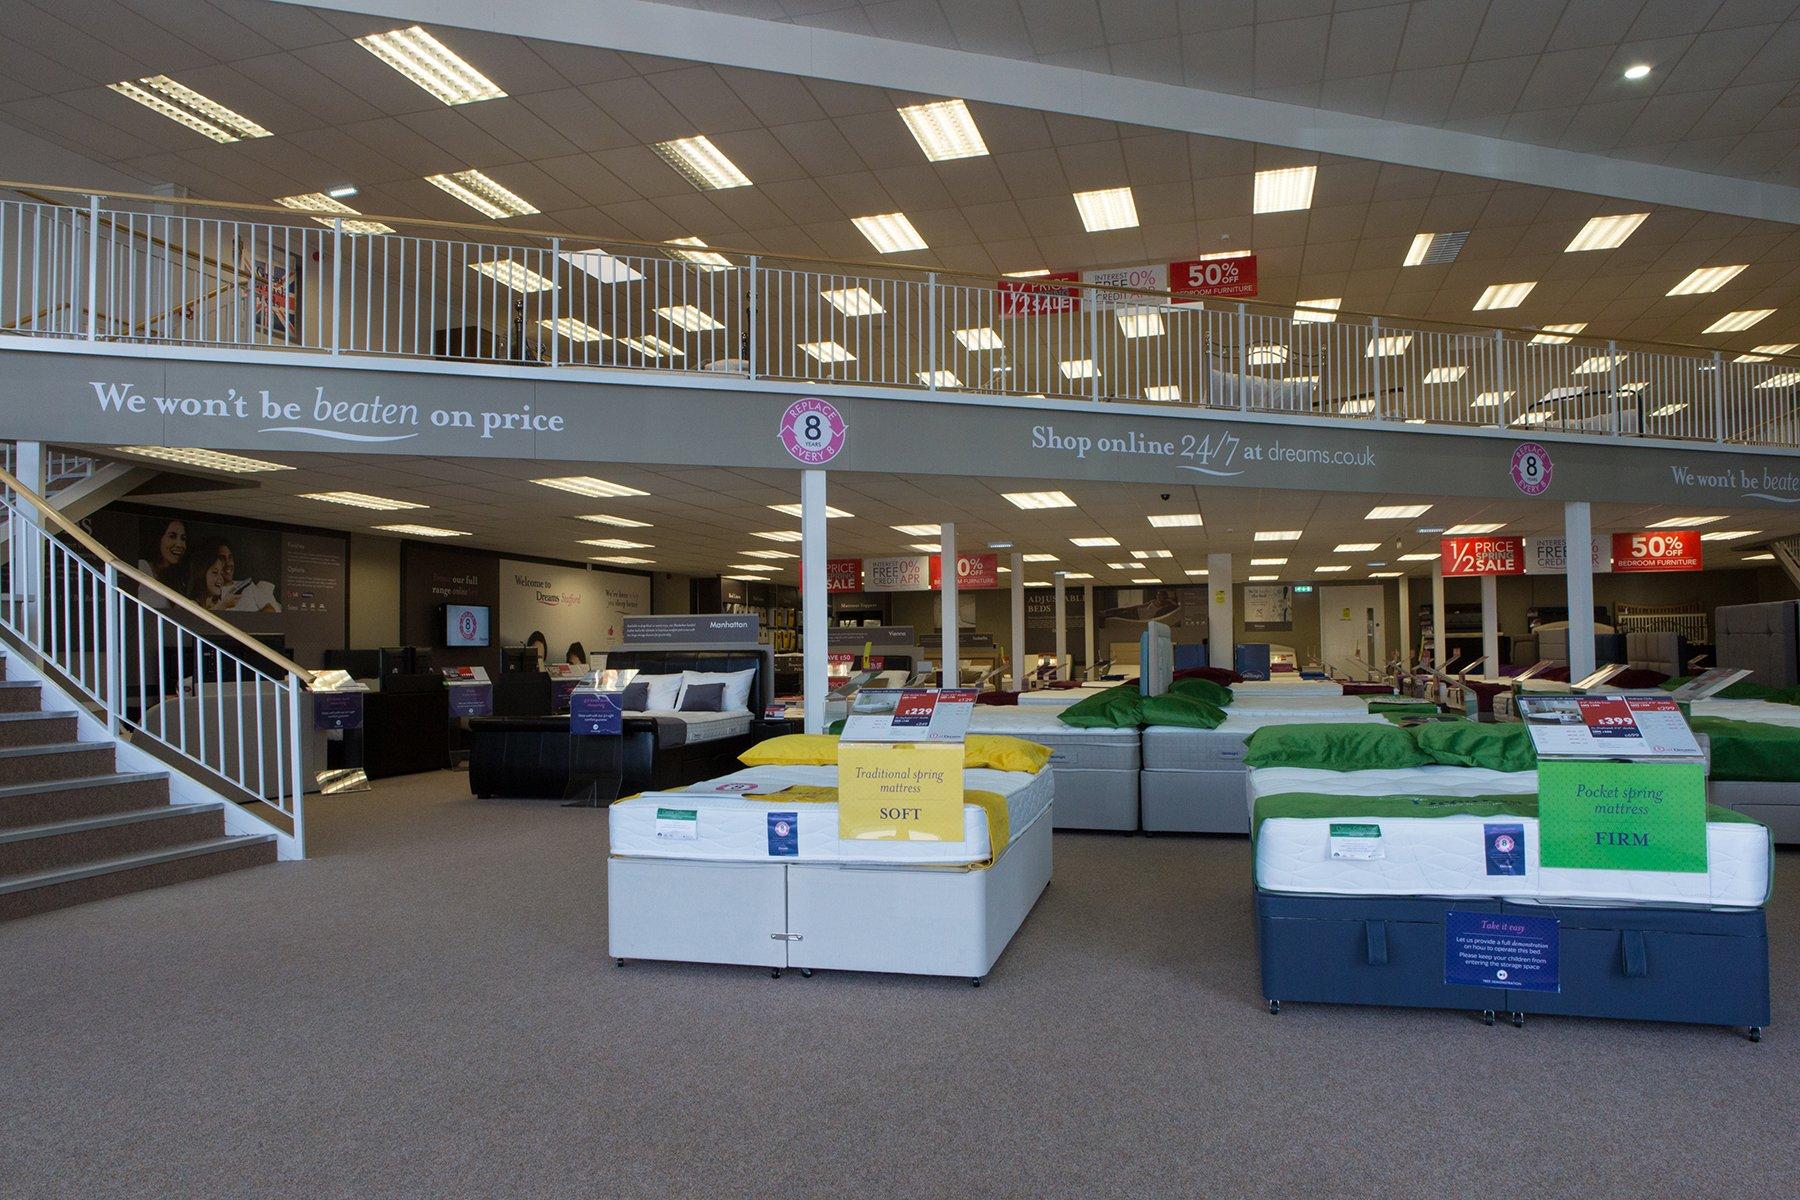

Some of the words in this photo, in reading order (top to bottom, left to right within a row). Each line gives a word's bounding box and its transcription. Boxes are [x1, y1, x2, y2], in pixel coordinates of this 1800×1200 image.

[1095, 272, 1127, 281] INTEREST
[1130, 270, 1155, 286] 0%
[1188, 262, 1239, 287] 50%
[1221, 276, 1239, 284] OFF
[1213, 285, 1253, 294] FURNITURE
[89, 382, 146, 413] We
[153, 388, 249, 418] won't
[259, 390, 301, 420] be
[313, 386, 419, 425] beaten
[430, 409, 475, 428] on
[481, 404, 564, 440] price
[789, 401, 837, 420] REPLACE
[805, 415, 821, 440] 8
[1032, 425, 1092, 459] Shop
[1097, 431, 1175, 456] online
[1180, 430, 1240, 467] 24/7
[1243, 446, 1263, 461] at
[1268, 440, 1376, 467] dreams.co.uk
[791, 444, 824, 462] EVERY
[1526, 456, 1538, 476] 8
[1670, 465, 1695, 486] We
[1697, 469, 1737, 488] won't
[1740, 469, 1760, 490] be
[1475, 541, 1514, 553] PRICE
[1631, 536, 1683, 557] 50%
[1476, 552, 1514, 560] SPRING
[900, 560, 920, 573] 0%
[957, 558, 983, 577] 0%
[1476, 560, 1515, 572] SALE
[1537, 558, 1567, 567] CREDI
[1618, 559, 1656, 567] BEDROOM
[1657, 558, 1697, 566] FURNITURE
[873, 566, 898, 578] FREE
[513, 575, 544, 589] Welcome
[545, 580, 552, 589] to
[827, 579, 855, 590] SALE
[900, 574, 920, 584] APR
[432, 586, 451, 598] range
[536, 591, 560, 602] Dreams
[1028, 594, 1084, 604] ADJUSABL
[1028, 604, 1051, 613] BEDS
[709, 621, 748, 629] Manhattan
[1598, 717, 1633, 725] £399
[856, 767, 911, 779] Traditional
[912, 769, 944, 783] spring
[880, 783, 921, 793] mattress
[1576, 784, 1619, 798] Pocket
[1622, 787, 1663, 804] spring
[880, 807, 922, 820] SOFT
[1594, 803, 1649, 815] mattress
[1595, 832, 1649, 846] FIRM
[1481, 920, 1500, 930] Take
[1501, 922, 1507, 930] it
[1509, 925, 1525, 933] easy
[1474, 938, 1496, 946] provide
[1511, 940, 1549, 949] demonstration
[1459, 951, 1478, 959] Please
[1478, 953, 1493, 961] keep
[1507, 955, 1531, 963] children
[1500, 962, 1522, 970] storage
